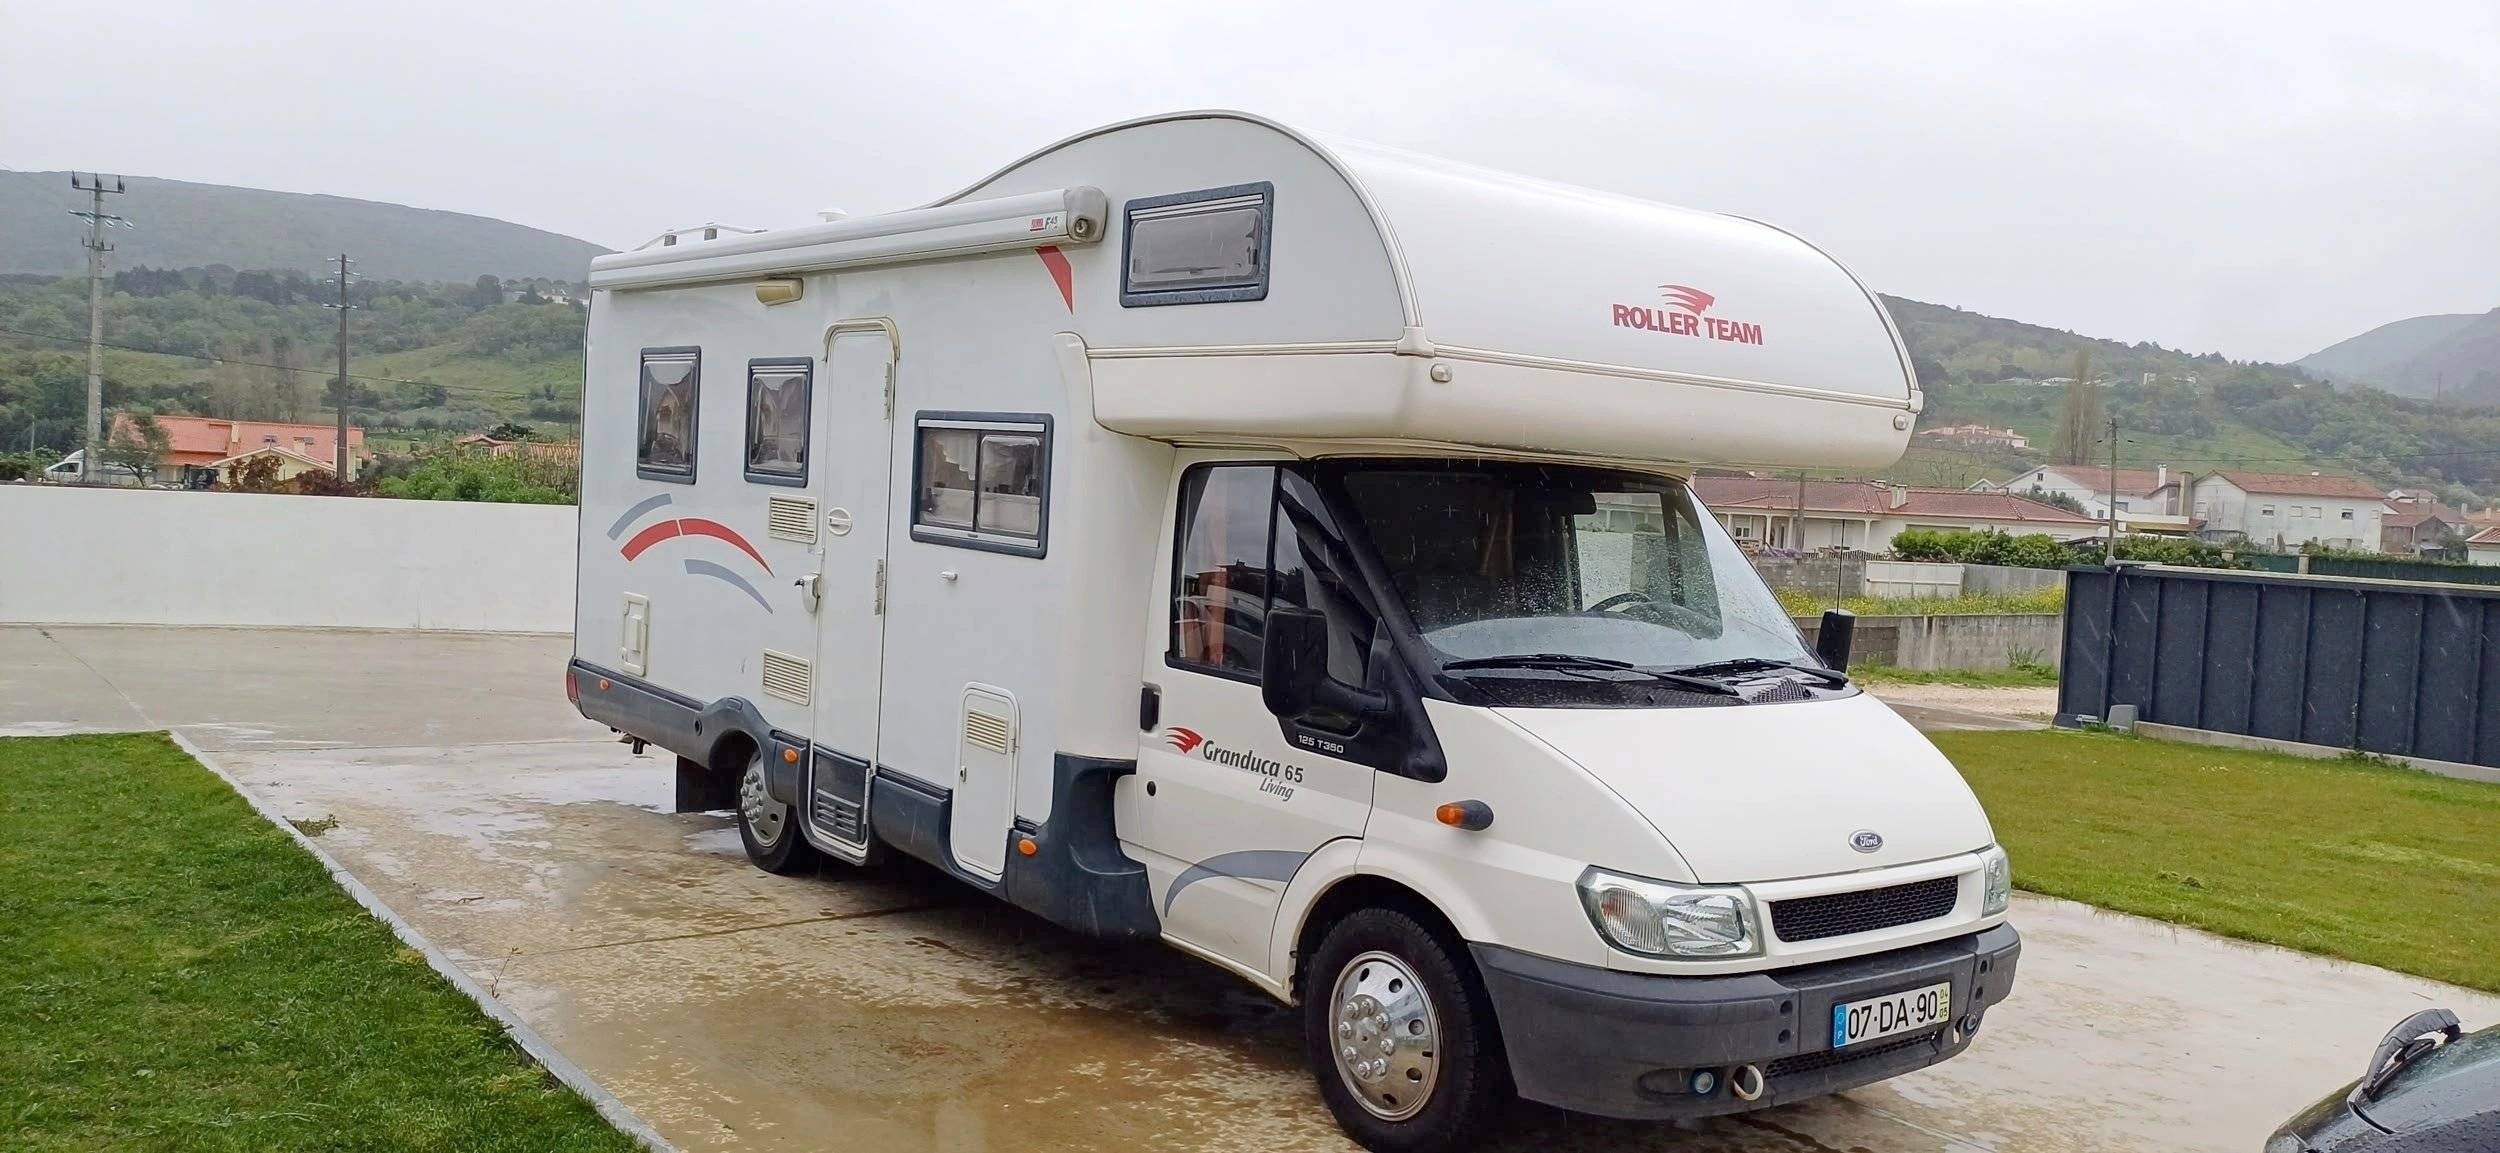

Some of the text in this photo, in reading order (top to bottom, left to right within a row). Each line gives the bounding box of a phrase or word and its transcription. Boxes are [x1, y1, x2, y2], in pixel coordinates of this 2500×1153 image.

[1612, 303, 1764, 345] ROLLER TEAM
[1298, 734, 1344, 753] 125 T350
[1203, 740, 1304, 783] Granduca 65
[1259, 777, 1295, 802] Living
[1859, 834, 1878, 847] Ford
[1939, 1007, 1948, 1018] 05
